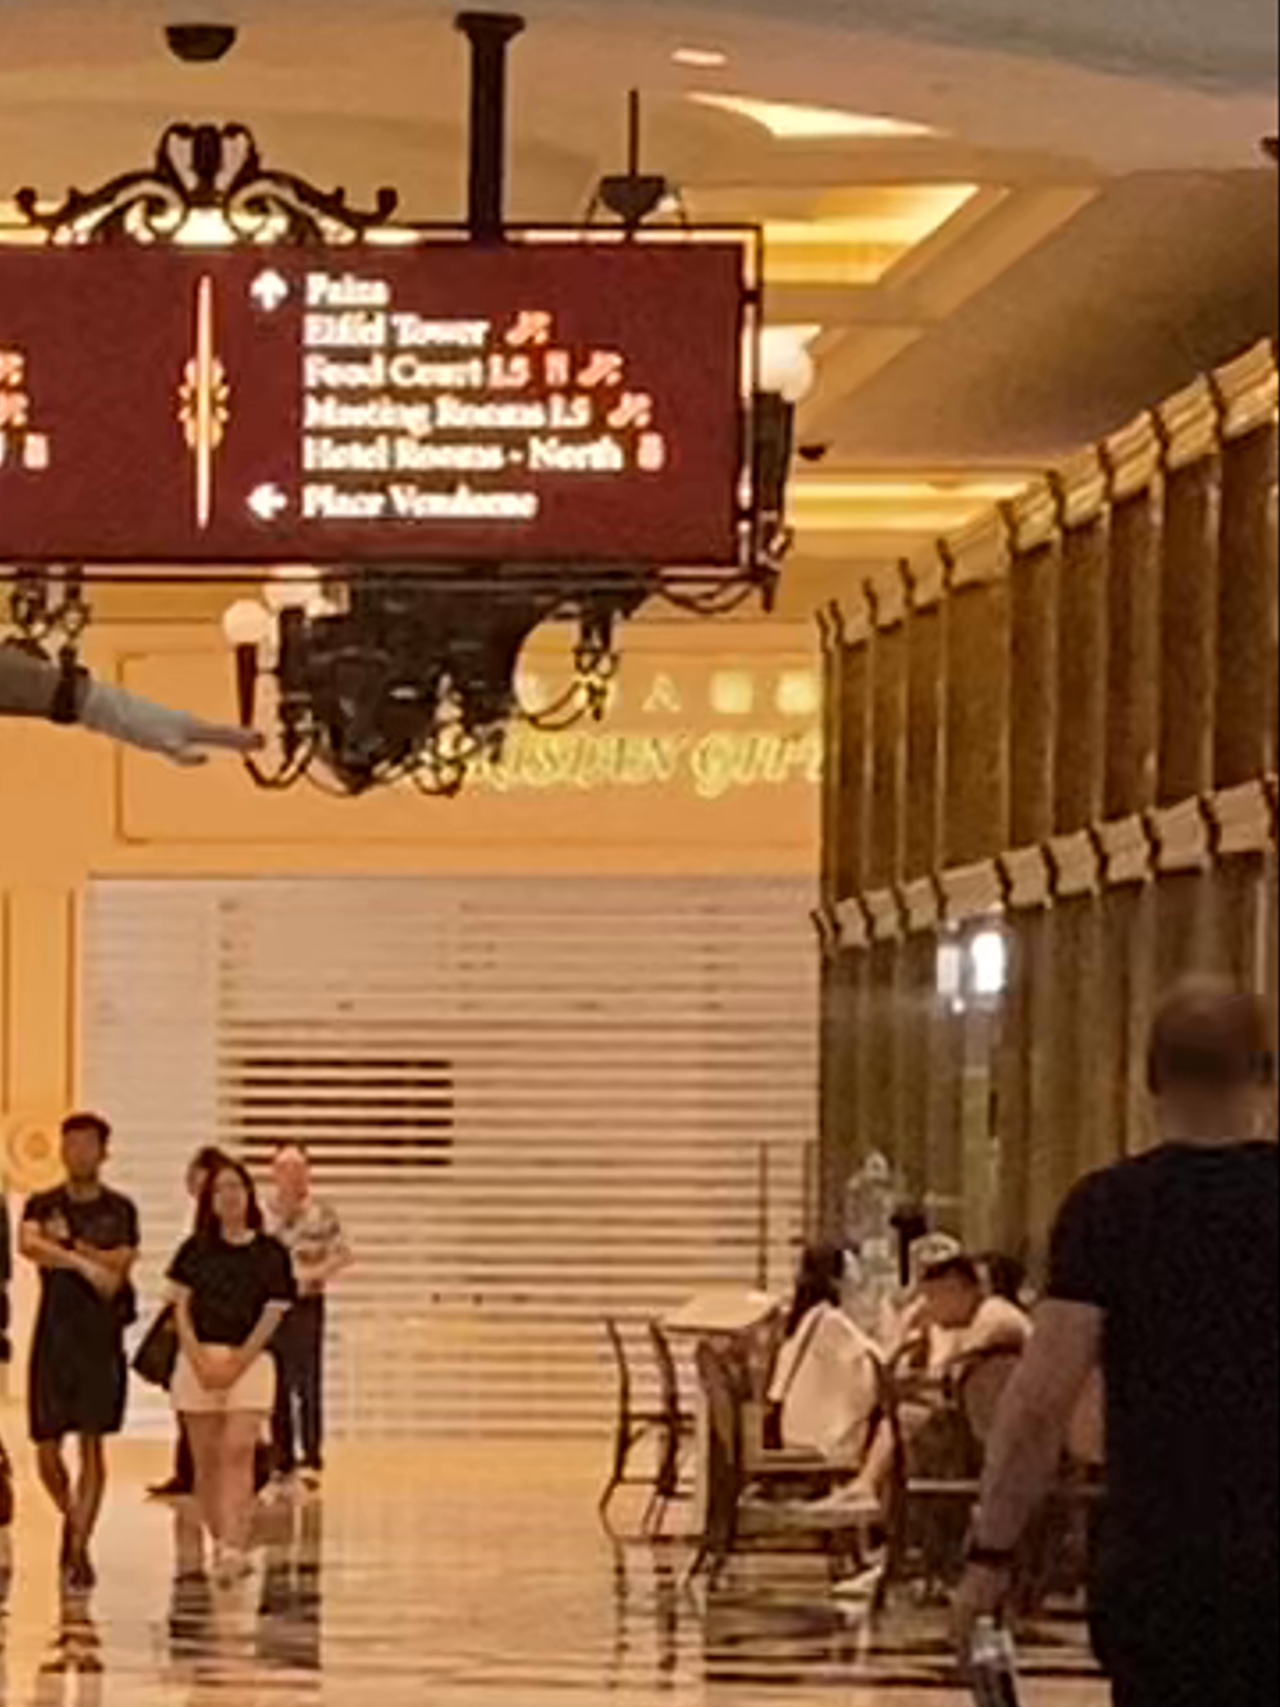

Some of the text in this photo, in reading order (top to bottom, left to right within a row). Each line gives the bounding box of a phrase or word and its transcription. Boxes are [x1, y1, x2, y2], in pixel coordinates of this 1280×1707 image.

[390, 314, 489, 346] Tower
[304, 353, 386, 387] Food
[389, 355, 482, 386] Court
[304, 395, 432, 438] Meeting
[435, 396, 546, 428] Rooms
[304, 436, 388, 470] Hotel
[394, 436, 505, 469] Rooms
[529, 436, 623, 470] North
[303, 485, 386, 517] Place
